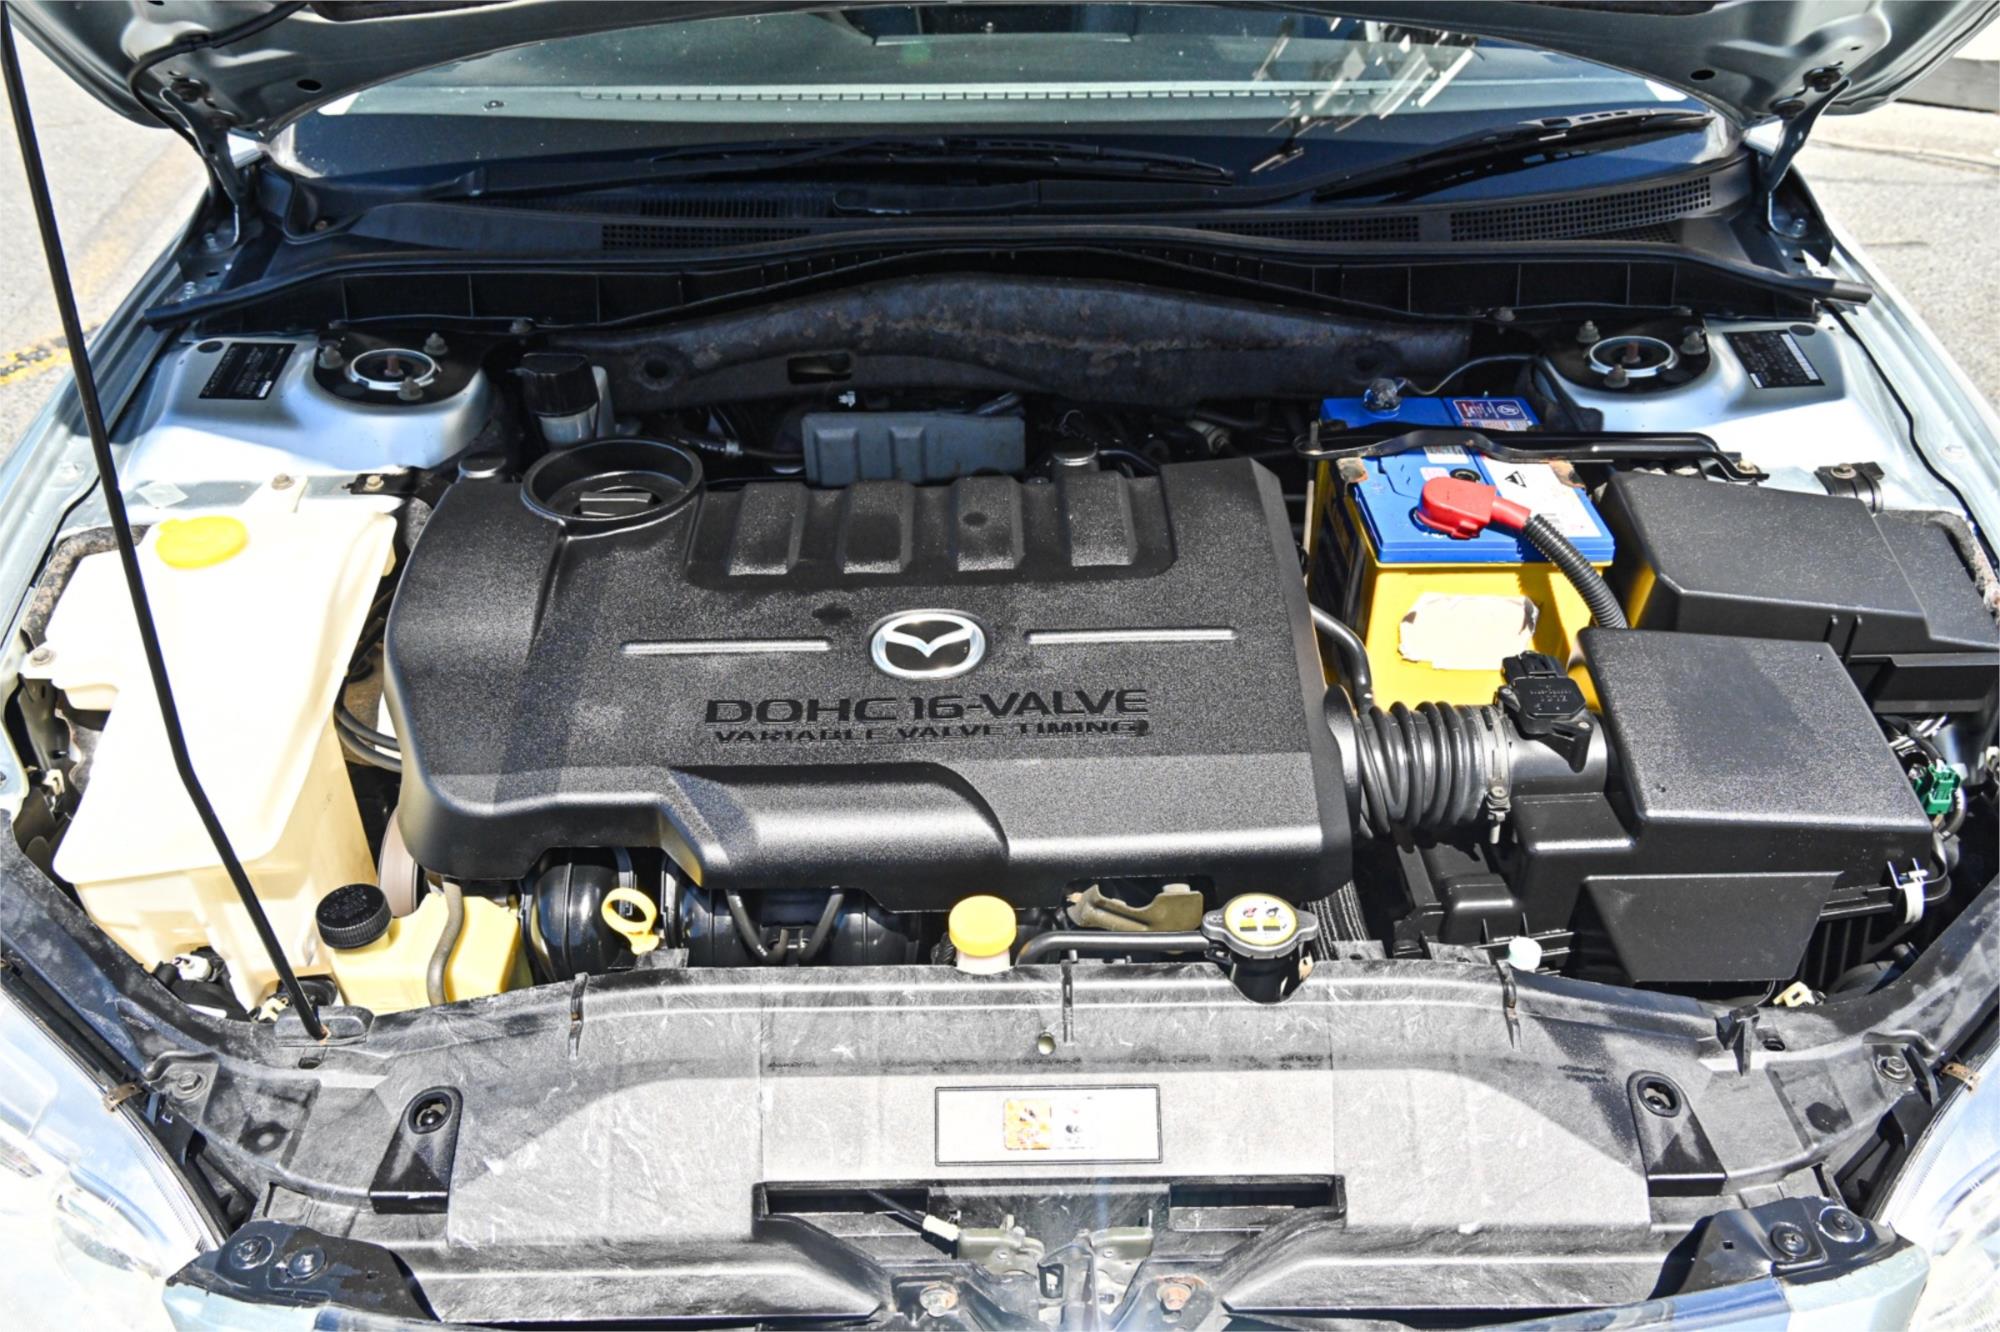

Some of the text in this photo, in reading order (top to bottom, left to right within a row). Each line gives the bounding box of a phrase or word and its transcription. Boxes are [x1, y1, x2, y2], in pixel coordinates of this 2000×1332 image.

[705, 689, 1149, 724] DOHC 16-VALVE
[714, 728, 887, 743] VARIABLE
[897, 724, 1002, 738] VALVE
